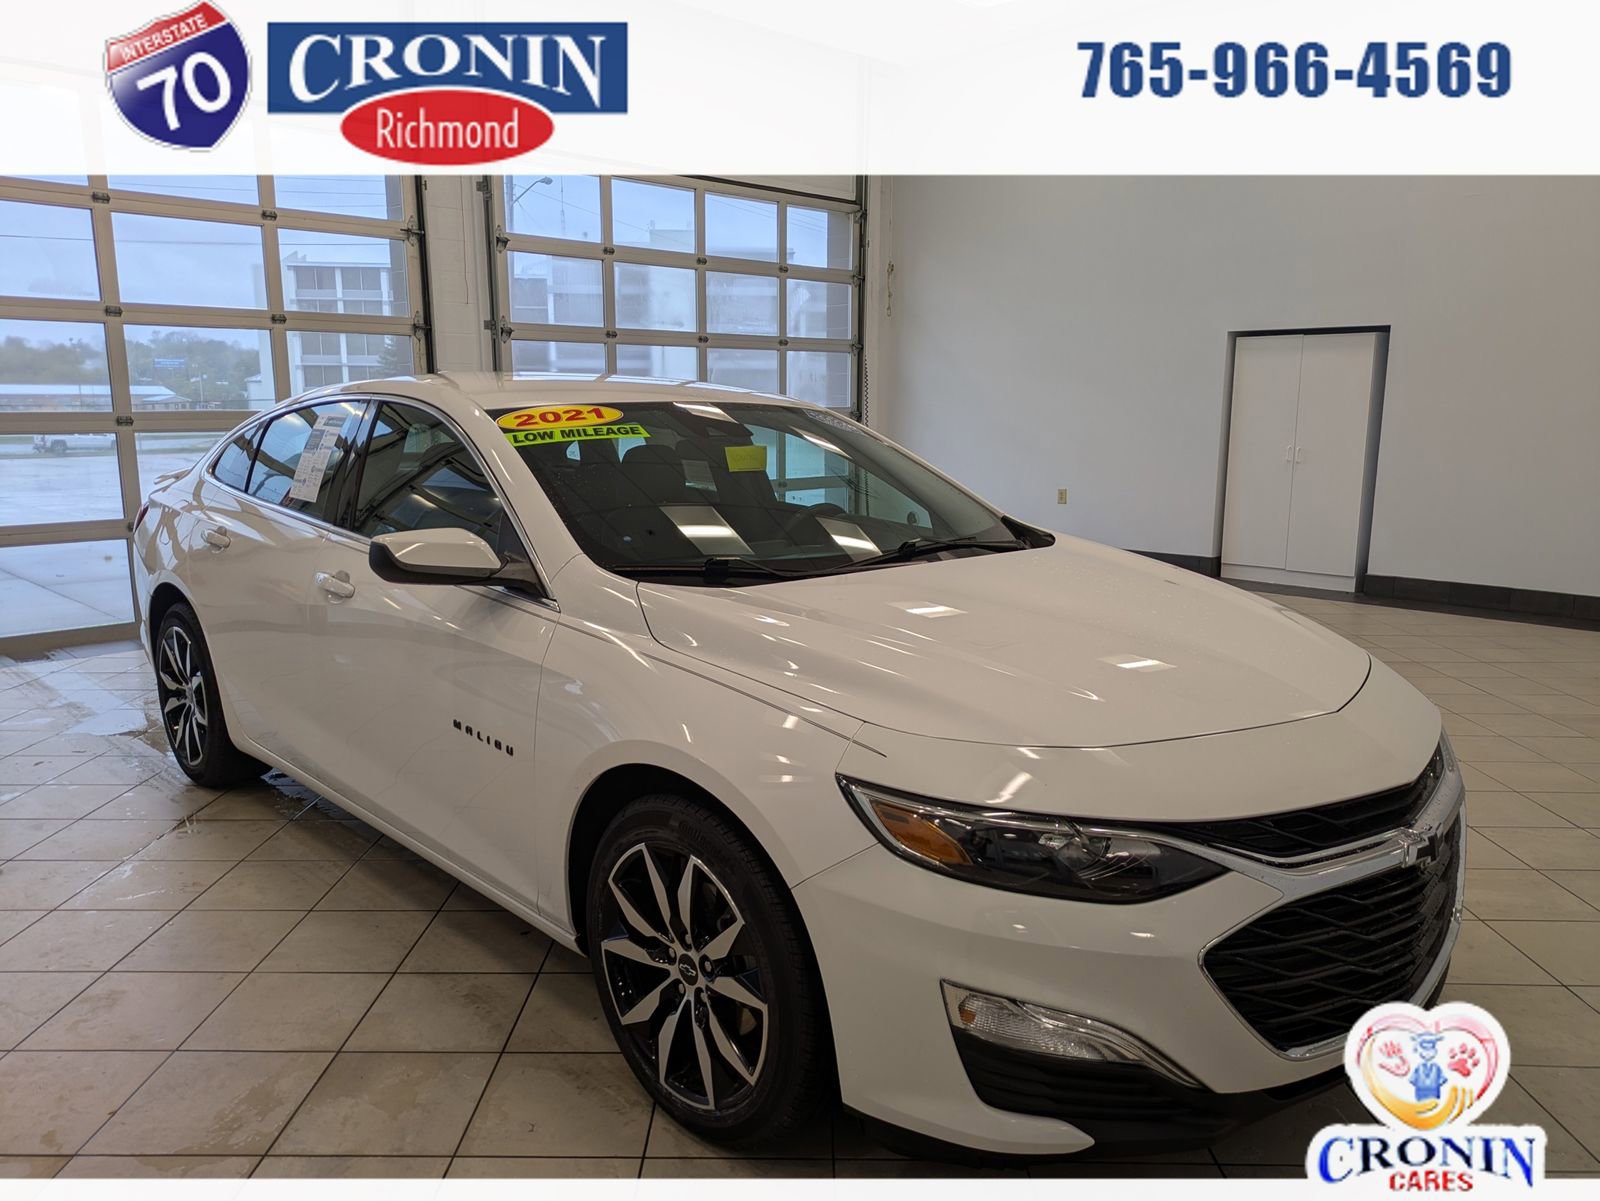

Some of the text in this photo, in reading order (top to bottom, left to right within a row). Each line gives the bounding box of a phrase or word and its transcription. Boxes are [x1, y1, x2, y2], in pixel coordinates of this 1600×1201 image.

[513, 407, 606, 428] 2021
[512, 425, 642, 445] LOW MILEAGE
[453, 719, 514, 757] MALIBU
